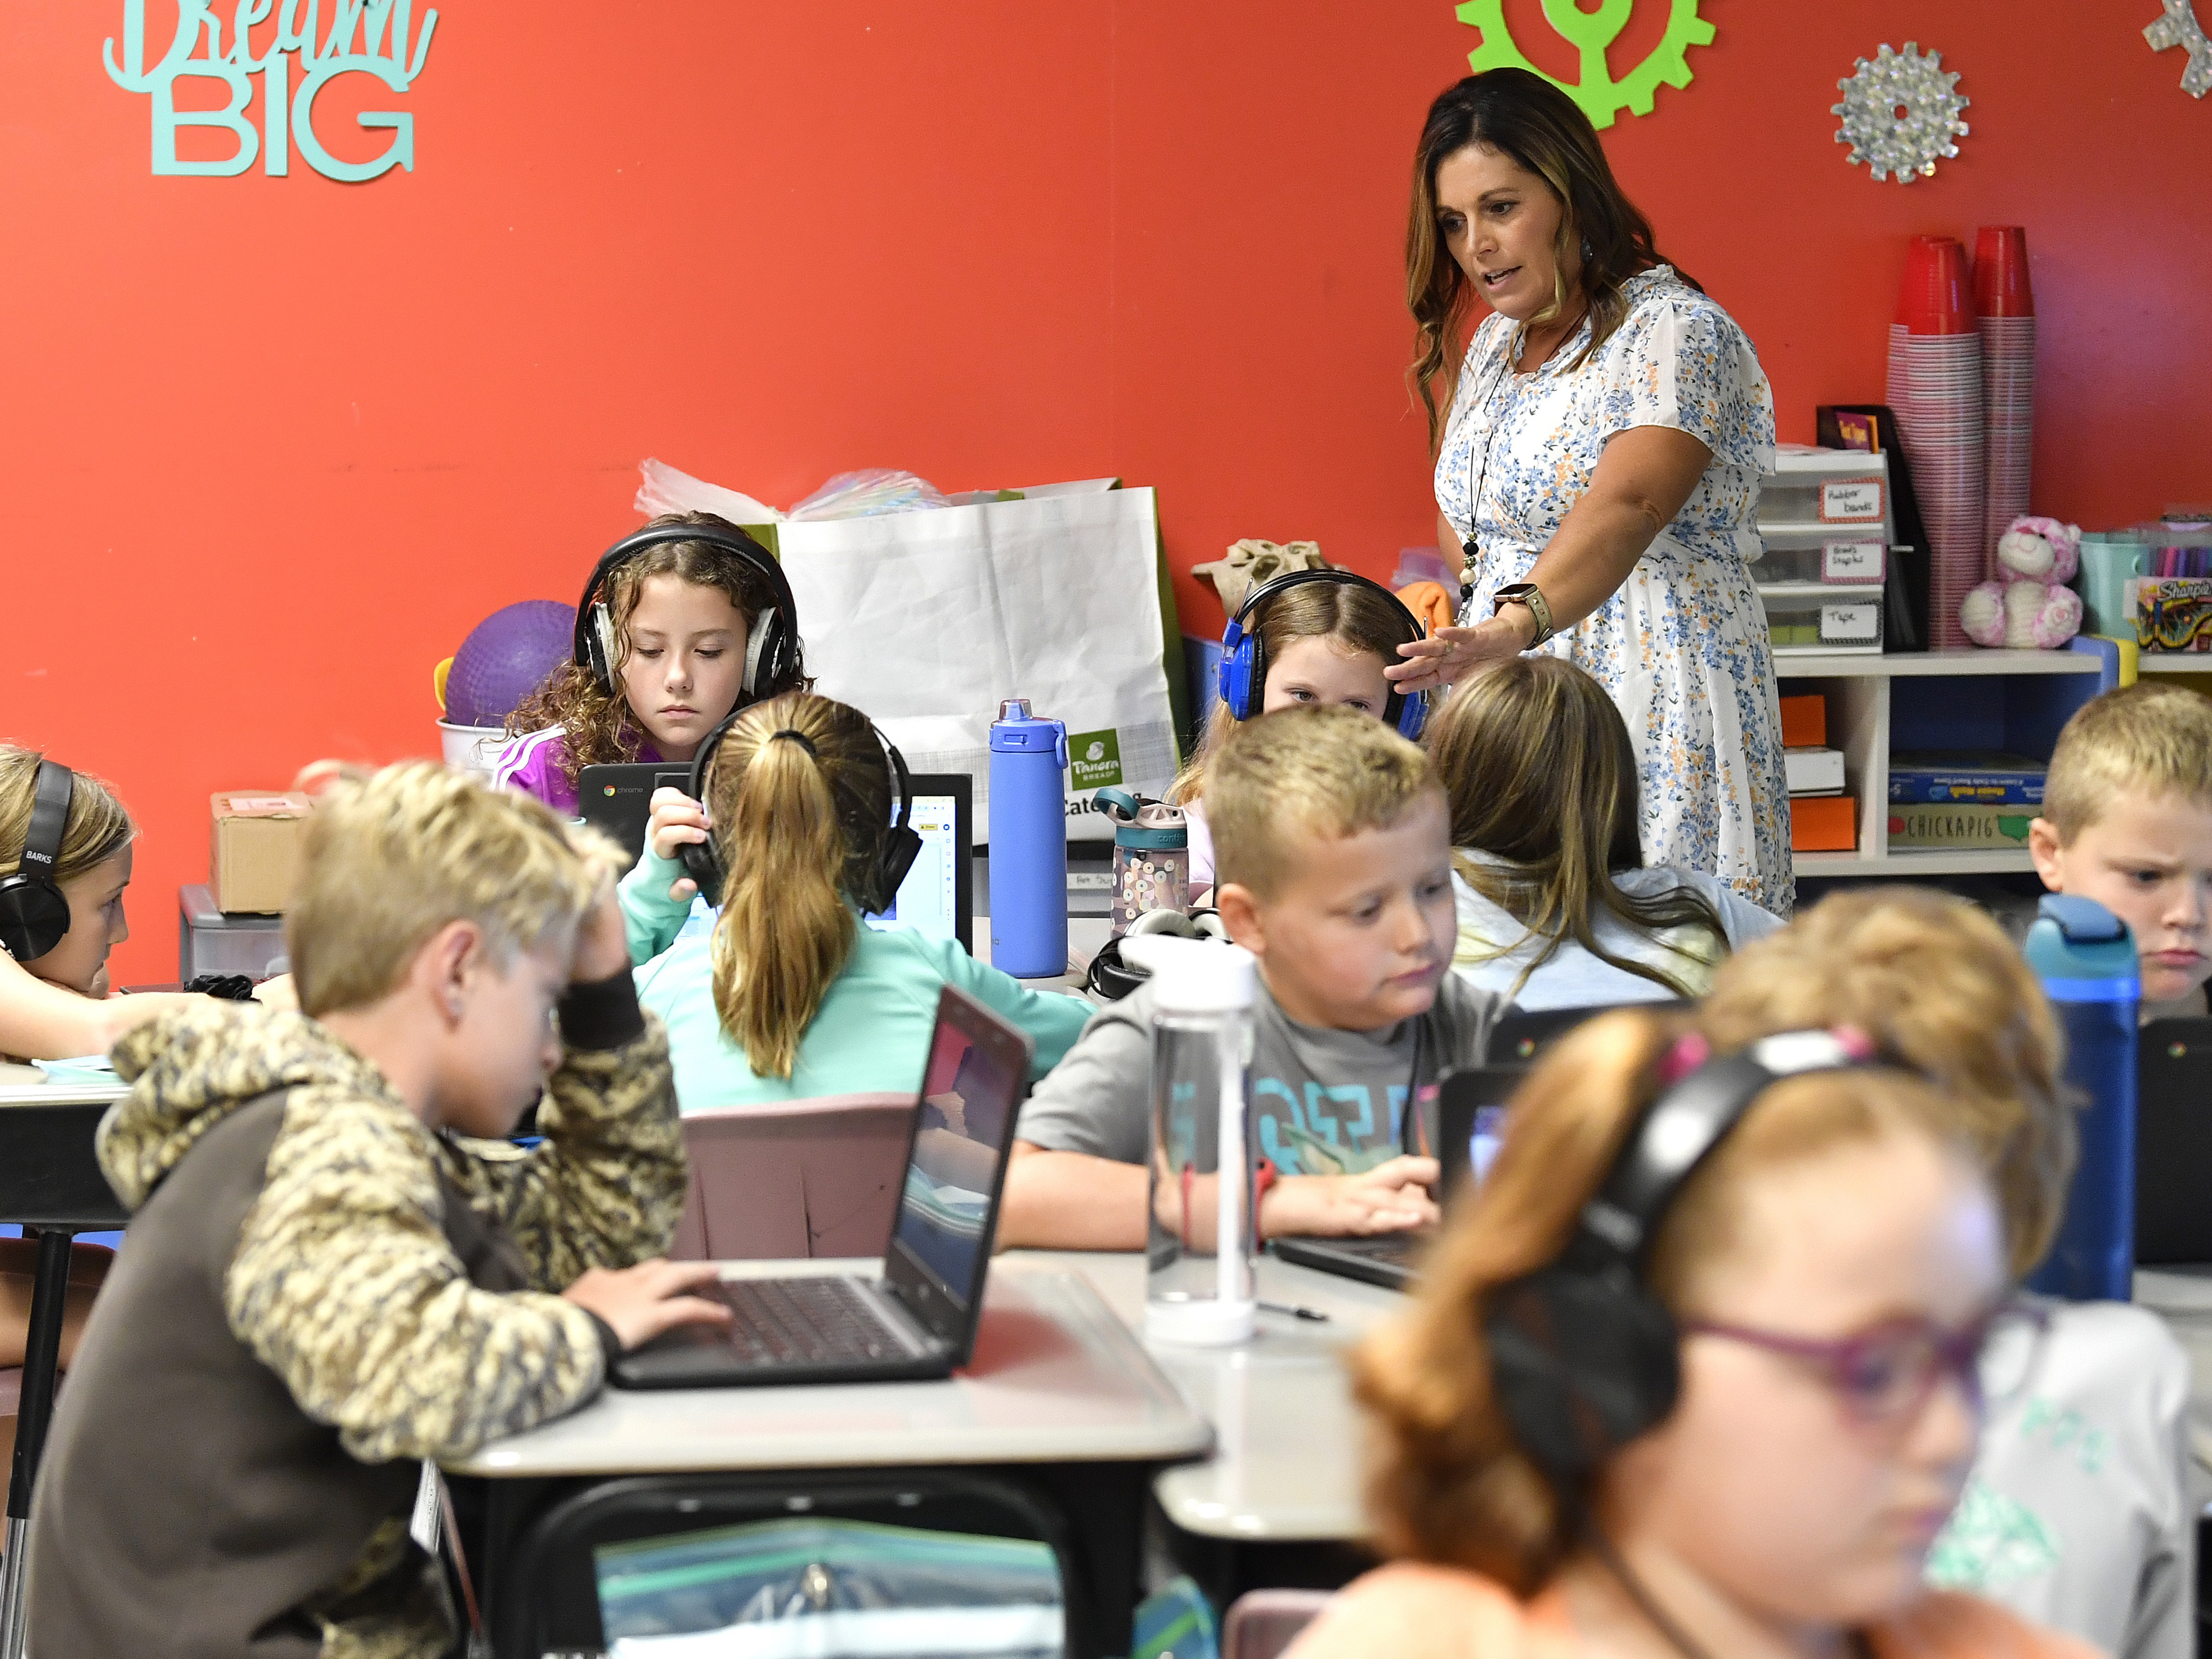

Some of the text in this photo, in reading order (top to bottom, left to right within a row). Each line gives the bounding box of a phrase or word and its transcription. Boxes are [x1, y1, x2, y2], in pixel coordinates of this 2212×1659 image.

[151, 53, 414, 182] BIG
[1907, 814, 1993, 837] CHICKAPIG
[26, 850, 52, 864] BARKS
